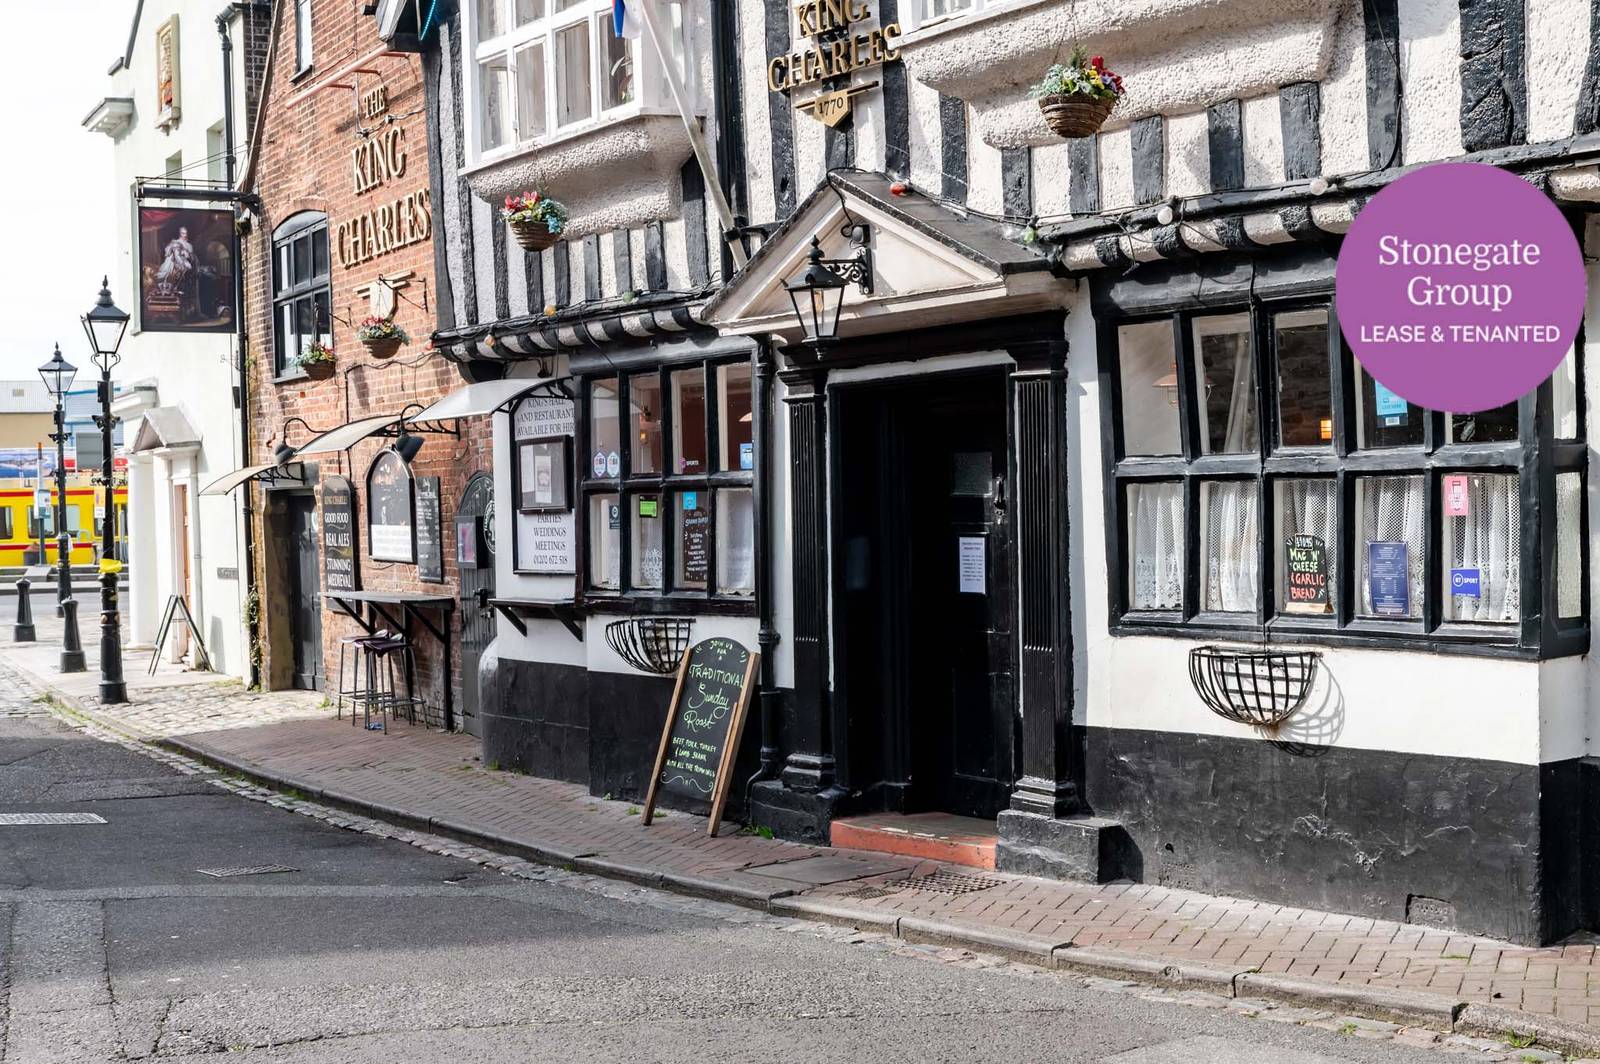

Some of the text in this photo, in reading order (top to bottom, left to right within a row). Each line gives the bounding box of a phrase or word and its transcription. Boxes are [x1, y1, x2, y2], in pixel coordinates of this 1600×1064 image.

[796, 0, 869, 37] KING
[768, 23, 901, 92] CHARLES
[364, 85, 387, 120] THE
[819, 97, 844, 116] 1770
[352, 127, 406, 195] KING
[337, 190, 431, 268] CHARLES
[534, 408, 575, 421] RESTAURANT
[517, 422, 575, 436] AVAILABLE FOR HIR
[325, 512, 348, 523] GOOD FOOD
[537, 513, 561, 523] PARTIES
[533, 527, 567, 537] WEDDINGS
[325, 533, 350, 547] REAL ALES
[535, 541, 567, 551] MEETINGS
[326, 558, 351, 571] STUNNING
[1292, 561, 1318, 573] CHEESE
[327, 574, 352, 588] MEDIEVAL
[1295, 573, 1325, 586] GARLIC
[1290, 587, 1316, 599] BREAD
[709, 640, 724, 649] JOIN
[689, 663, 744, 688] TRADITIONAL
[688, 682, 730, 719] Sunday
[683, 710, 717, 733] Roast
[699, 742, 717, 753] TURKEY
